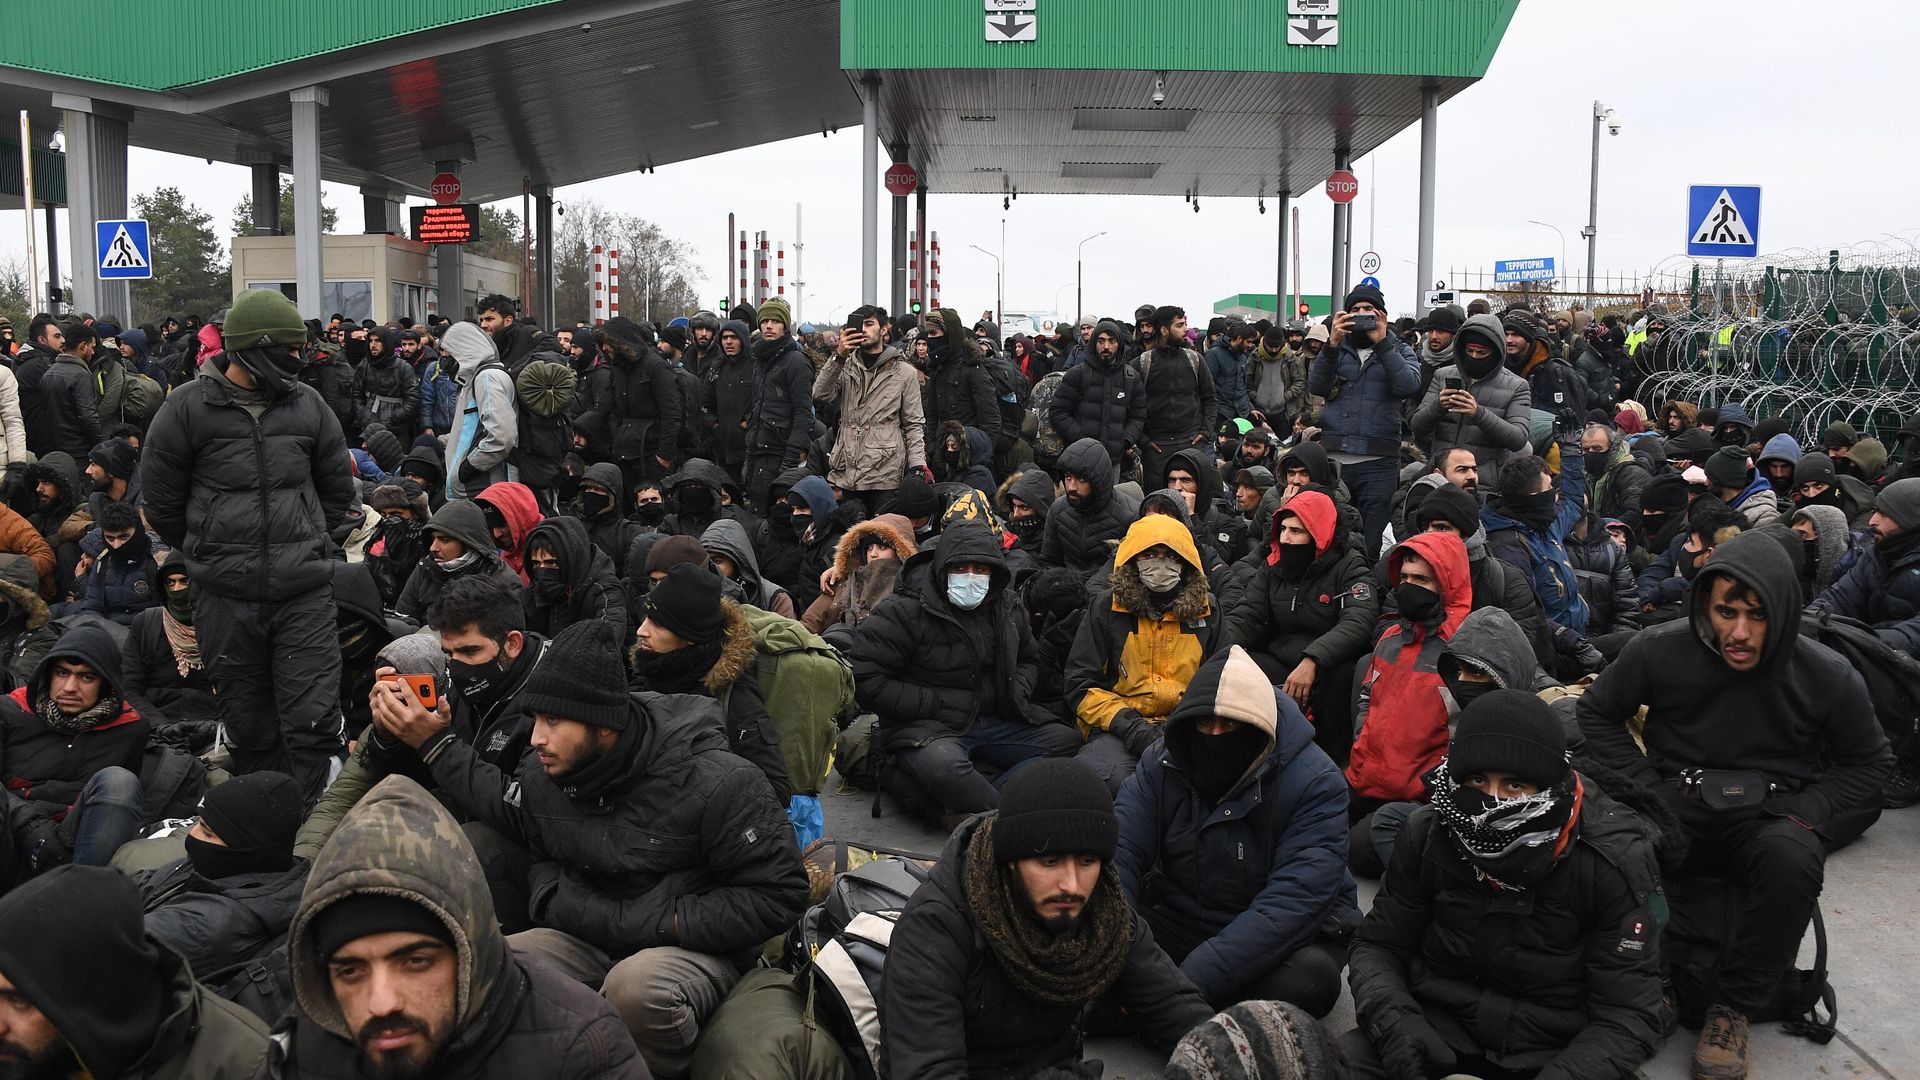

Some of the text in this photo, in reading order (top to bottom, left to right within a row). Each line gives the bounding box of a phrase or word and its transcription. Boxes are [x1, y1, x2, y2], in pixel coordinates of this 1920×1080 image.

[887, 174, 915, 185] STOP
[432, 184, 460, 195] STOP
[1328, 181, 1357, 192] STOP
[1364, 259, 1376, 268] 20
[1505, 260, 1544, 271] ТЕРРИТОРИЯ
[1497, 269, 1553, 281] ПУНКТА ПРОПУСКА
